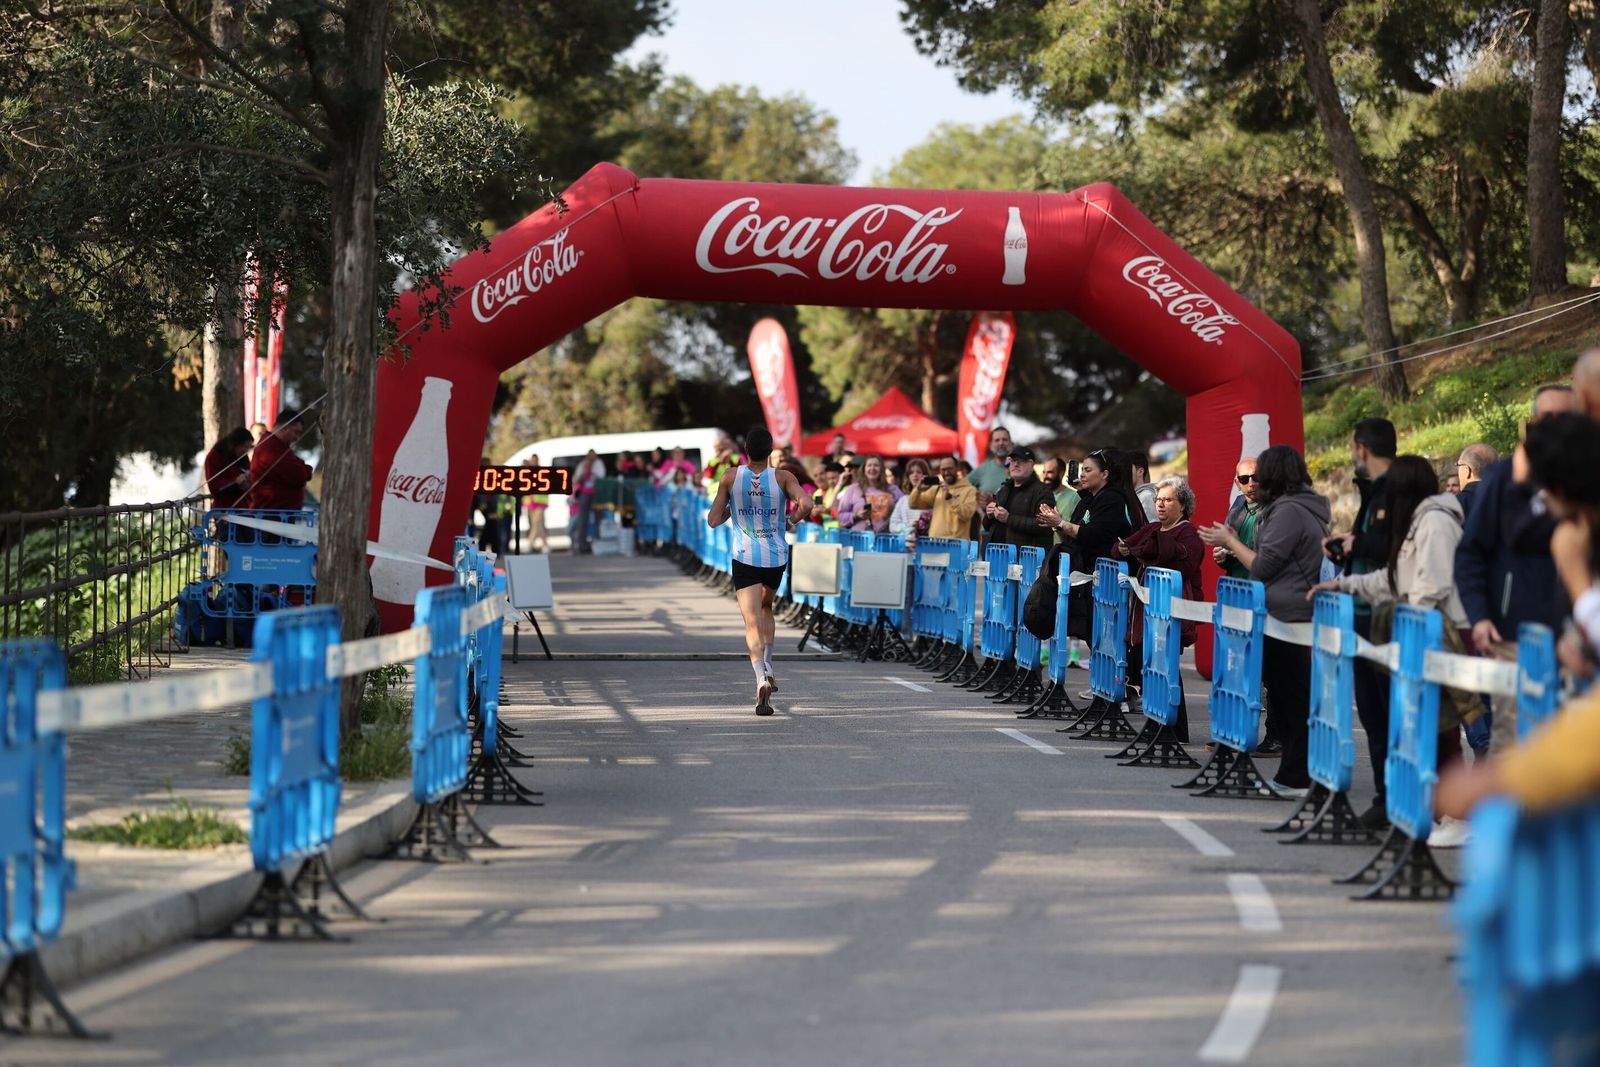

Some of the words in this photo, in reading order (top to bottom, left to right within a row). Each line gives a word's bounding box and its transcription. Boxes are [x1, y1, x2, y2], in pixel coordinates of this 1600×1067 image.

[471, 228, 581, 323] Coca-Cola
[695, 196, 964, 284] Coca-Cola
[1122, 255, 1239, 343] Coca-Cola
[738, 505, 777, 518] málaga
